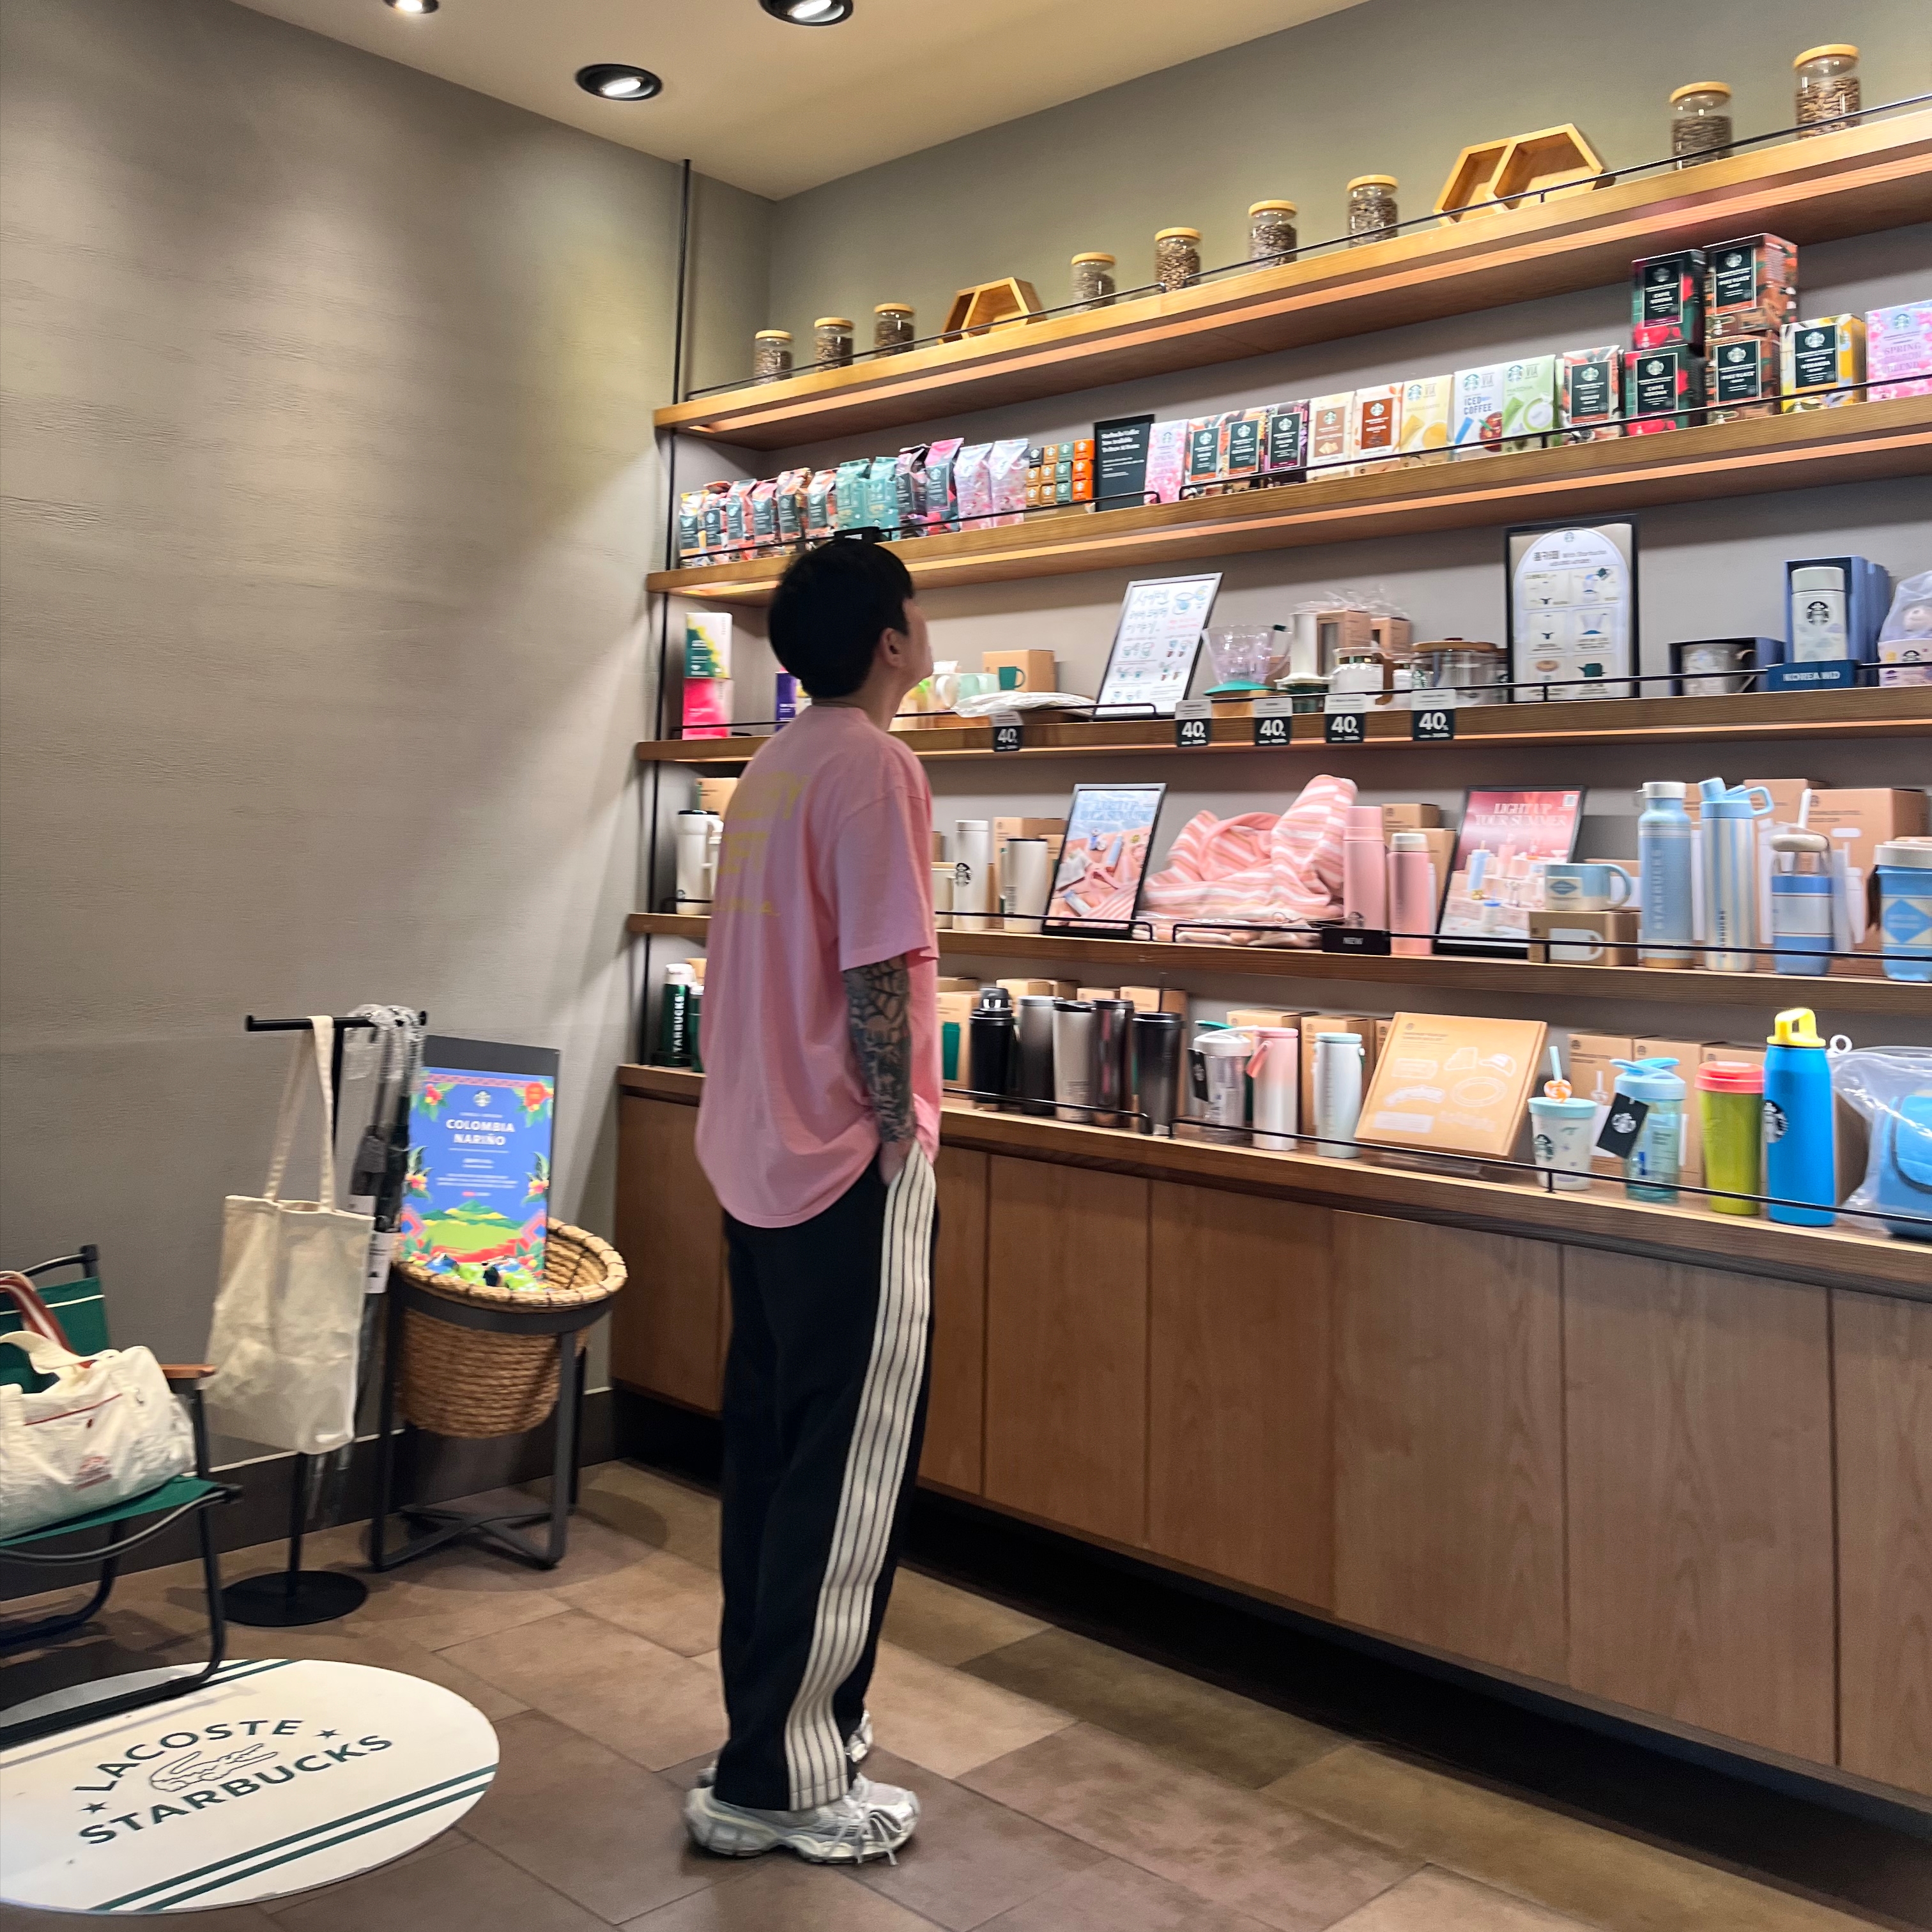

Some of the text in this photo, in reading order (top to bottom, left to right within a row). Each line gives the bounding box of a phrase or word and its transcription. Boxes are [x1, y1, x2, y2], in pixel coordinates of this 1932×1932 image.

[1884, 342, 1922, 354] SPRING
[1464, 396, 1482, 406] ICED
[1464, 403, 1493, 415] COFFEE
[1652, 848, 1664, 929] STARBUCKS
[445, 1119, 516, 1133] COLOMBIA
[453, 1133, 507, 1146] NARIÑO
[73, 1719, 305, 1792] LACOSTE
[79, 1735, 394, 1844] STARBUCKS
